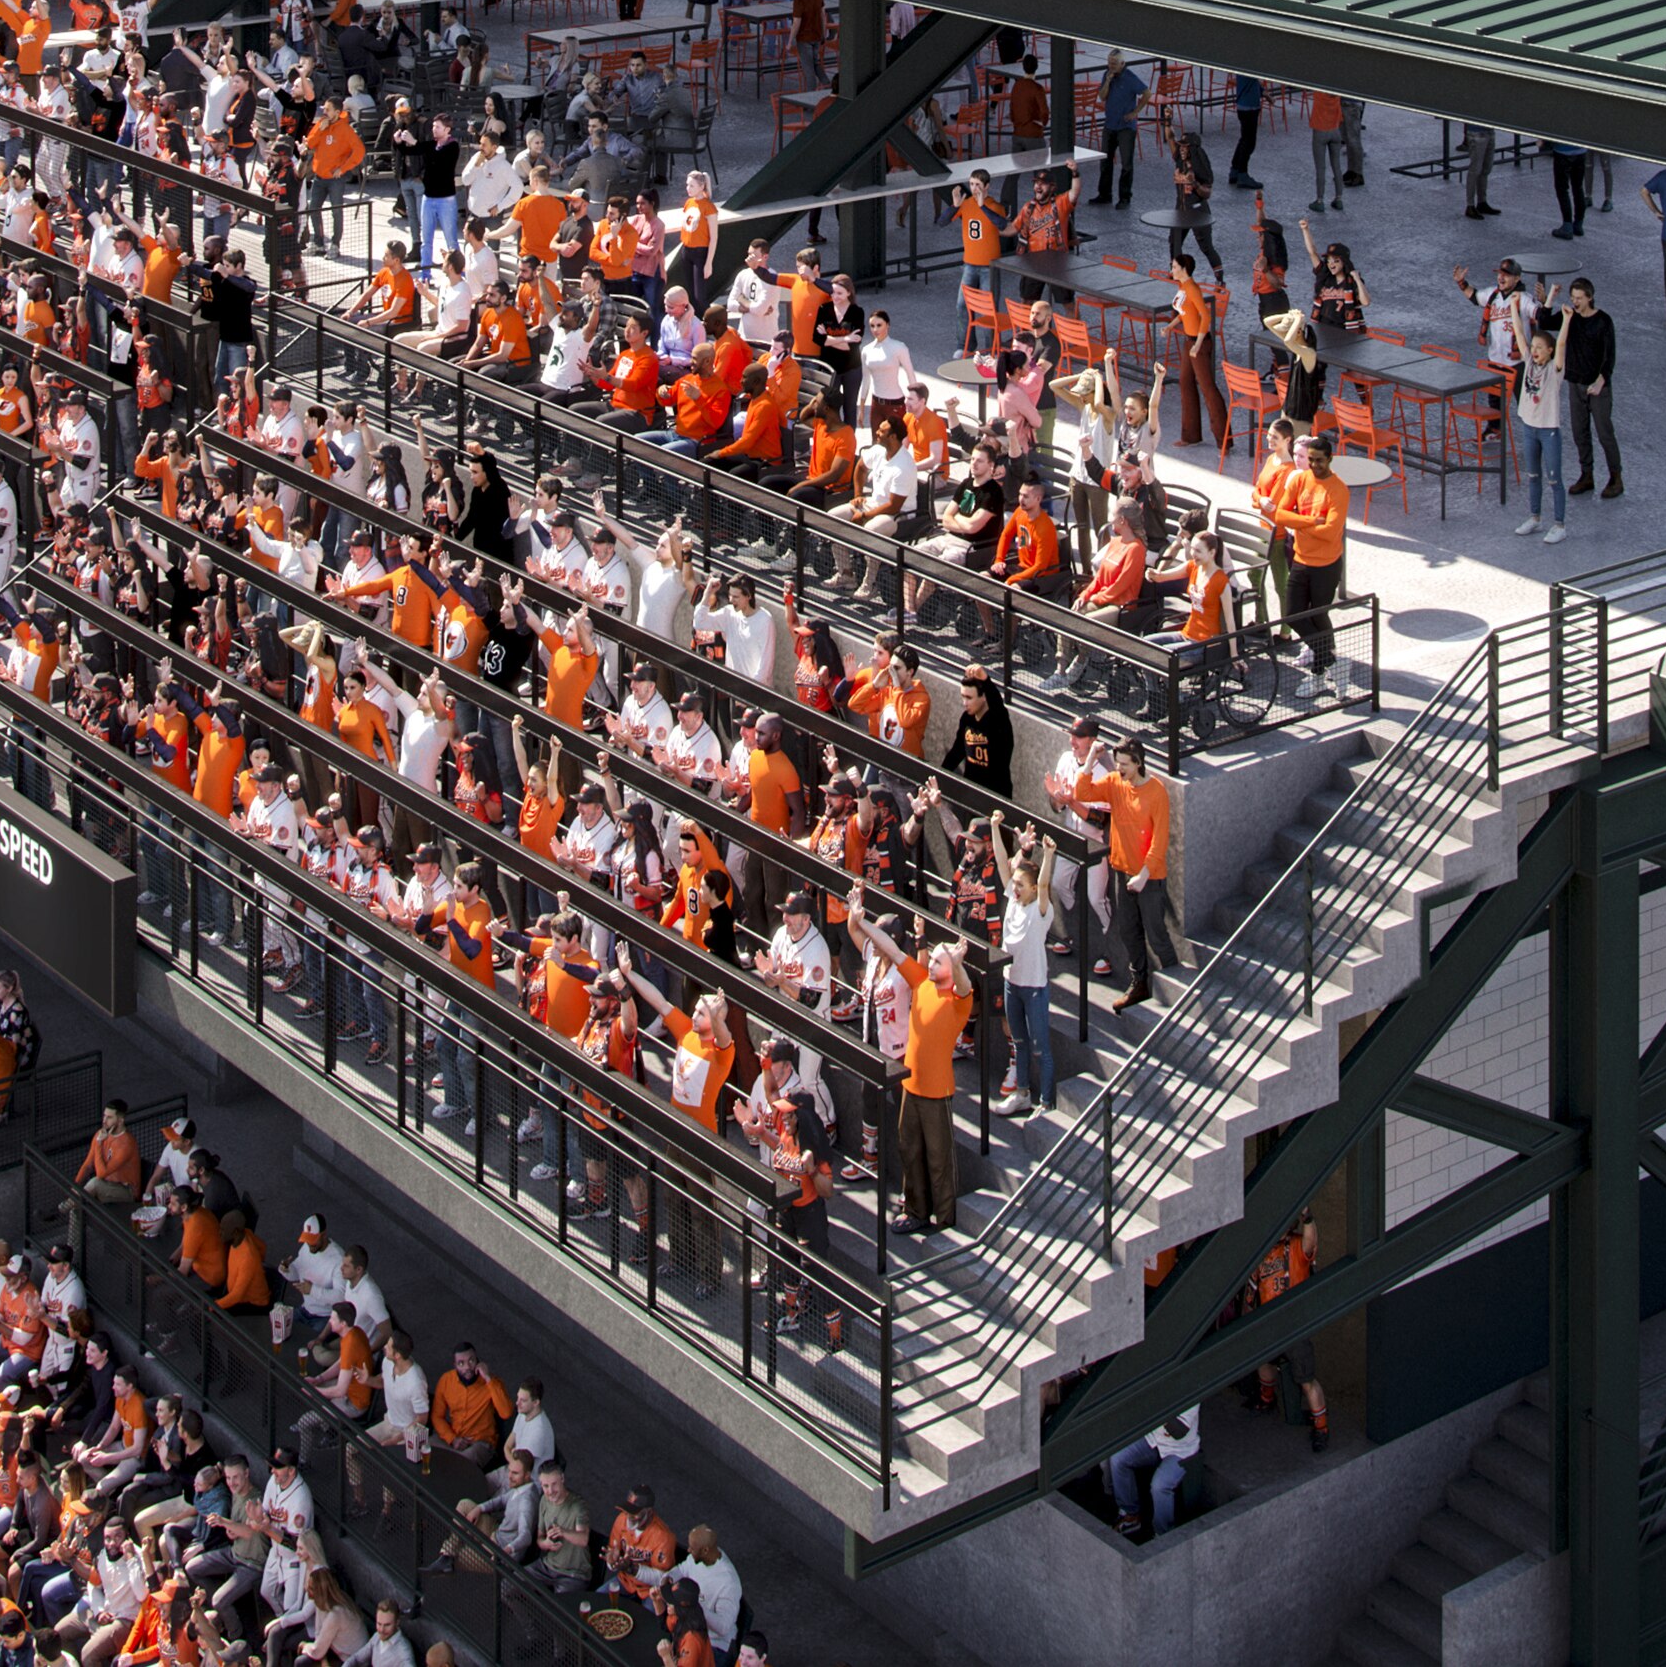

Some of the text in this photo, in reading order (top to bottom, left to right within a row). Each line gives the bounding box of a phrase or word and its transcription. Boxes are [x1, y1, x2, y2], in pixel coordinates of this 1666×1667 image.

[122, 17, 138, 32] 24
[969, 219, 981, 240] 8
[396, 584, 408, 606] 8
[975, 745, 989, 762] 01
[688, 886, 700, 916] 8
[881, 1008, 896, 1024] 24
